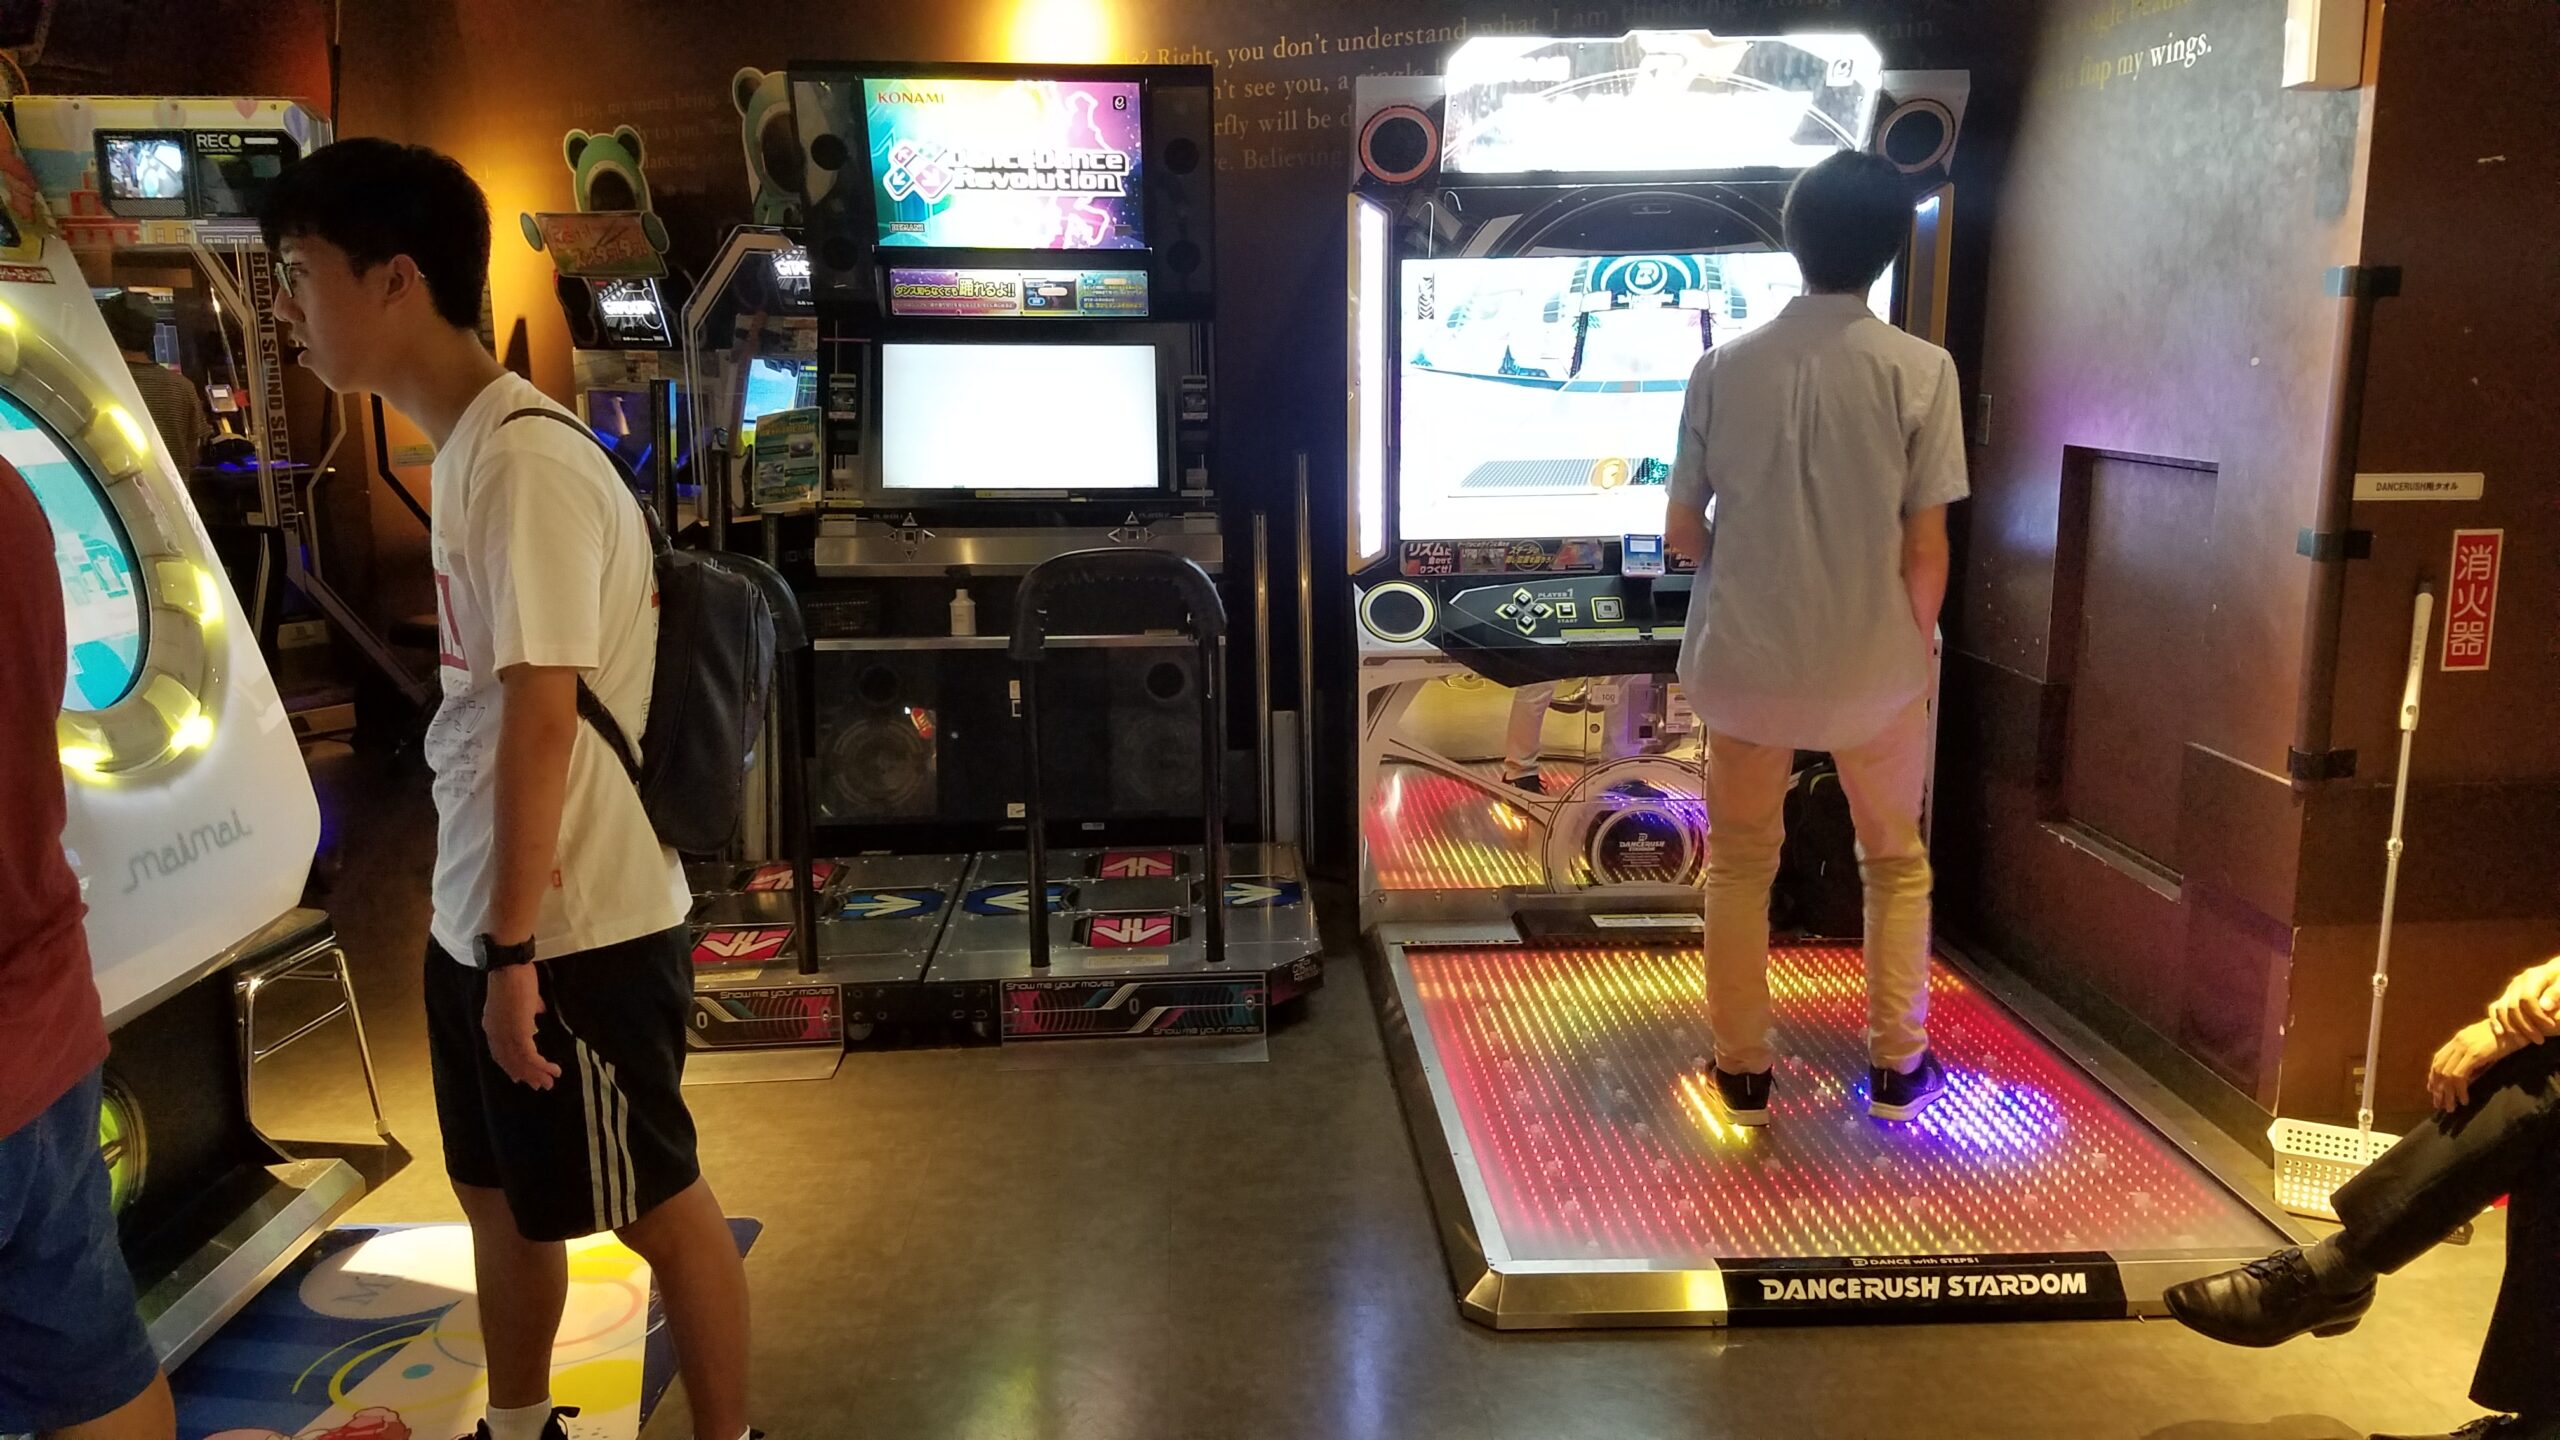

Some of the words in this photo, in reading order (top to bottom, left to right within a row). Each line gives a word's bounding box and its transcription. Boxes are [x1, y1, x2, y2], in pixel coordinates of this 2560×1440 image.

[1228, 44, 1264, 69] you
[1273, 35, 1328, 60] don't
[1337, 16, 1467, 53] understand
[2117, 51, 2144, 81] my
[2150, 32, 2212, 68] wings.
[878, 92, 944, 104] KONAMI
[1244, 80, 1275, 99] see
[1284, 77, 1329, 101] you,
[1337, 74, 1350, 91] a
[1258, 109, 1298, 133] will
[1307, 107, 1332, 131] be
[954, 167, 1117, 190] Revolution
[252, 252, 270, 333] BEMANI
[261, 338, 281, 411] SOUND
[2449, 543, 2493, 657] 消火器
[121, 808, 253, 894] maimai
[720, 991, 750, 1000] Show
[752, 990, 769, 998] me
[771, 989, 796, 999] your
[799, 987, 835, 996] moves
[1005, 982, 1035, 990] Show
[1036, 981, 1052, 989] me
[1055, 981, 1080, 990] your
[1081, 980, 1115, 988] moves
[1153, 1027, 1181, 1035] Show
[1200, 1026, 1225, 1035] your
[1226, 1025, 1260, 1033] moves
[1870, 1258, 1911, 1266] DANCE
[1758, 1275, 1940, 1300] DANCERUSH
[1947, 1272, 2087, 1298] STARDOM
